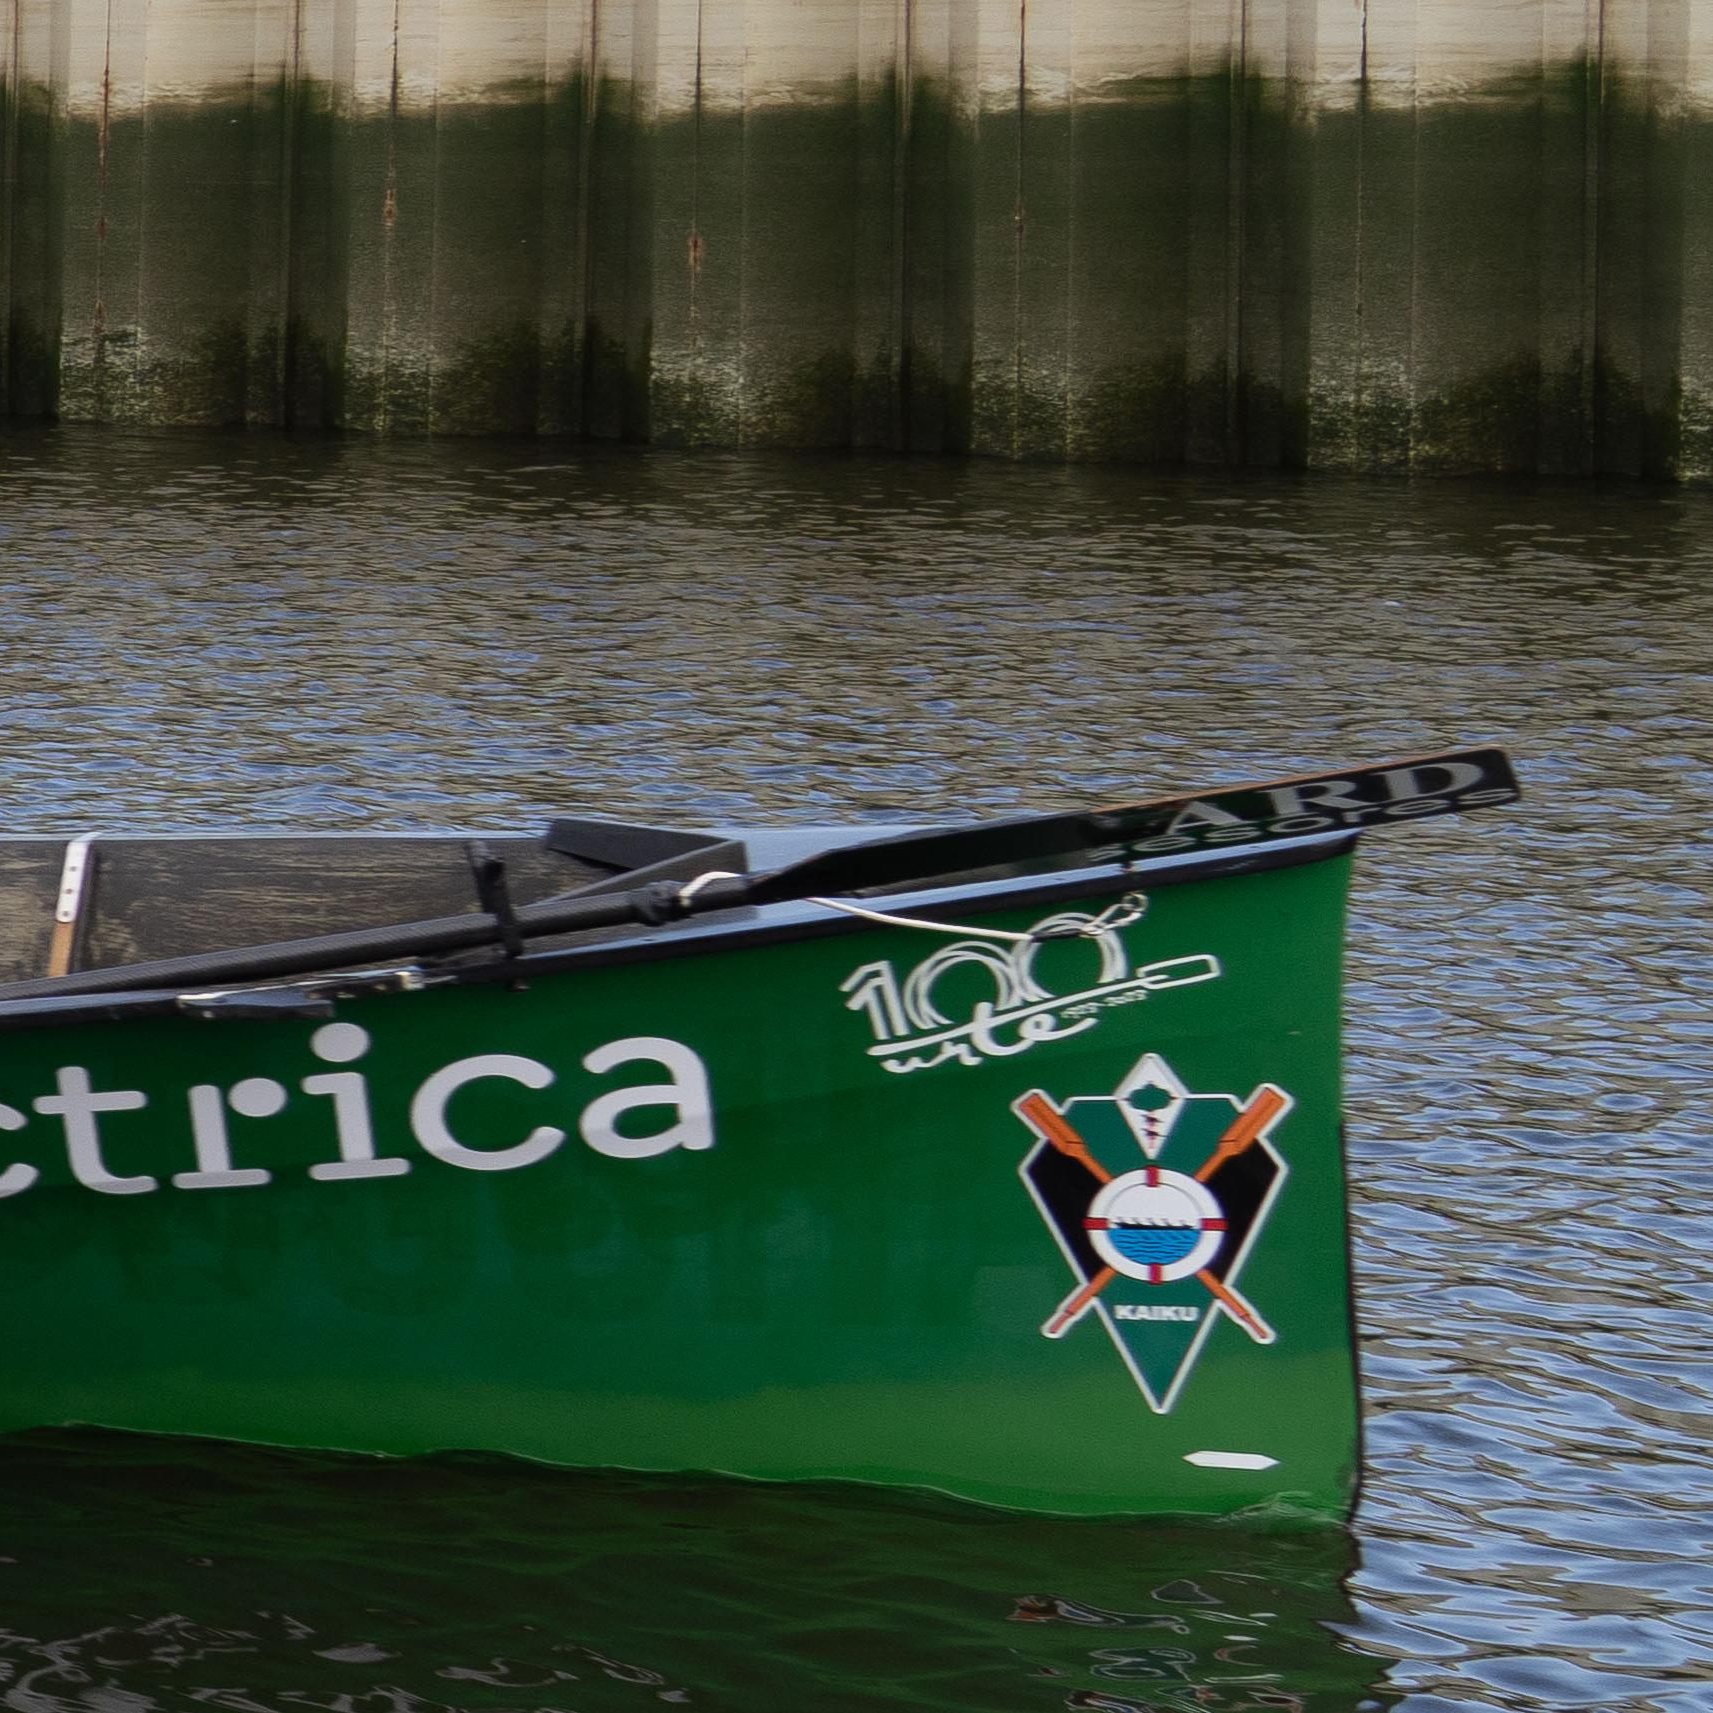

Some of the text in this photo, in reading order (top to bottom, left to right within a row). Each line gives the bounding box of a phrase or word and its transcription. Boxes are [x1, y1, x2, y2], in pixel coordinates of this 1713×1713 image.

[839, 912, 1129, 1041] 100
[880, 1001, 1099, 1074] urte
[1114, 1303, 1200, 1324] KAIKU
